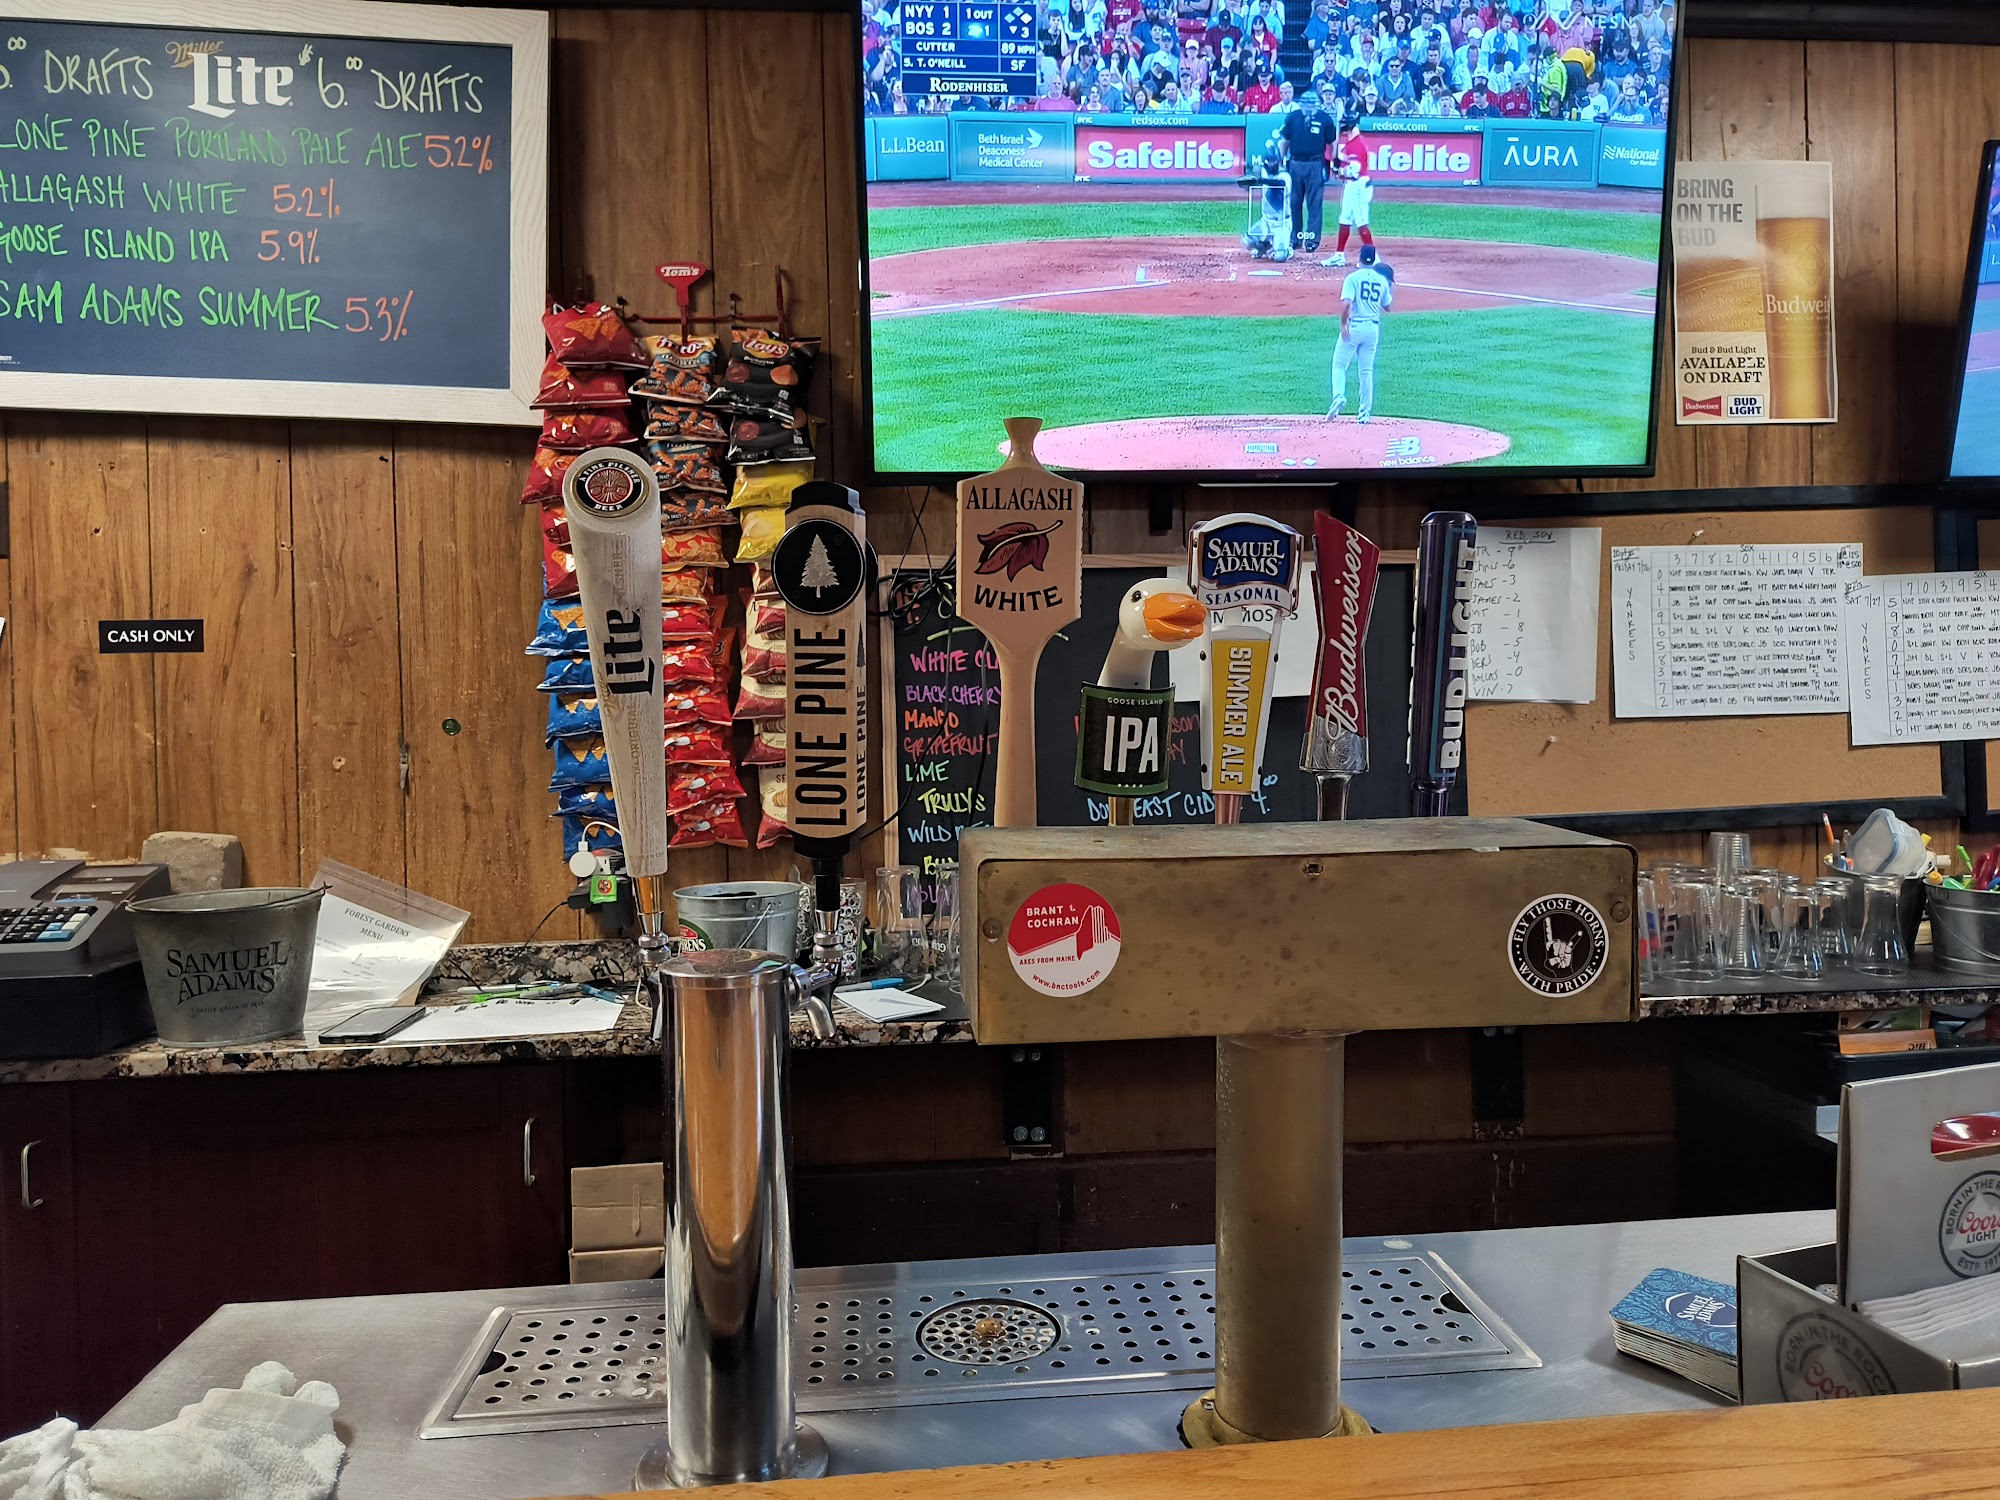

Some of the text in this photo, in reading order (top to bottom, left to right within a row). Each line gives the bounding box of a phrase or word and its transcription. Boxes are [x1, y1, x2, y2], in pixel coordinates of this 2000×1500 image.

[905, 4, 950, 19] NYY 1
[966, 7, 993, 20] 1 OUT
[905, 22, 951, 36] BOS 2
[1021, 26, 1030, 38] 3
[165, 40, 225, 68] Miller
[916, 41, 956, 52] CUTTER
[1001, 42, 1036, 55] 89 MPH
[927, 58, 967, 69] O'NEILL
[1010, 59, 1026, 72] SF
[44, 48, 153, 100] DRAFTS
[187, 52, 294, 118] Lite
[371, 64, 483, 113] DRAFTS
[1131, 115, 1189, 126] redsox.com
[1372, 121, 1428, 132] redsox.com
[82, 119, 155, 157] PINE
[164, 116, 288, 167] PORTLAND
[291, 127, 353, 165] PALE
[364, 132, 423, 169] ALE
[424, 134, 493, 174] 5.2%
[880, 136, 945, 154] L.L.Bean
[978, 133, 1024, 145] Beth Israel
[978, 145, 1025, 156] Deaconess
[1087, 140, 1235, 170] Safelite
[1615, 148, 1660, 161] National
[978, 156, 1044, 168] Medical Center
[0, 168, 341, 219] ALLAGASH WHITE 5.2%
[1677, 178, 1734, 199] BRING
[1677, 203, 1743, 223] ON THE
[0, 221, 320, 264] GOOSE ISLAND IPA 5.9%
[1678, 227, 1716, 246] BUD
[660, 265, 700, 277] Tom's
[1360, 280, 1382, 302] 65
[0, 280, 414, 342] SAM ADAMS SUMMER 5.3%
[1691, 346, 1708, 354] Bud
[1735, 346, 1756, 355] Light
[1684, 372, 1762, 383] ON DRAFT
[1685, 402, 1720, 411] Budweiser
[1729, 406, 1762, 415] LIGHT
[1734, 397, 1757, 406] BUD
[1379, 456, 1435, 468] new balance
[607, 462, 641, 484] PILSNER
[593, 503, 623, 511] BEER
[966, 485, 1074, 512] ALLAGASH
[1505, 530, 1525, 540] RED
[1207, 538, 1285, 559] SAMUEL
[1740, 544, 1755, 552] SOX
[1212, 557, 1279, 577] ADAMS
[974, 583, 1063, 613] WHITE
[1205, 587, 1281, 606] SEASONAL
[1324, 529, 1363, 742] Budweiser
[603, 609, 655, 697] Lite
[910, 646, 969, 673] WHITE
[1440, 538, 1477, 770] BUD LIGHT
[1473, 683, 1499, 697] VIN
[1107, 696, 1164, 706] GOOSE ISLAND
[1220, 646, 1252, 785] SUMMER ALE
[793, 628, 848, 826] LONE PINE
[856, 685, 867, 814] LONE PINE
[1103, 715, 1159, 774] IPA
[905, 760, 949, 782] LIME
[907, 820, 952, 843] WILD
[1026, 905, 1063, 917] BRANT
[344, 907, 411, 937] FOREST GARDENS
[1027, 916, 1079, 929] COCHRAN
[1513, 898, 1605, 948] FLY THOSE HORNS
[360, 927, 384, 941] MENU
[167, 941, 288, 977] SAMUEL
[1019, 958, 1035, 966] AXES
[177, 967, 275, 1006] ADAMS
[1032, 969, 1101, 991] www.bnctools.com
[1518, 961, 1597, 993] WITH PRIDE
[1945, 1178, 1995, 1235] BORN IN THE
[1966, 1229, 1997, 1244] LIGHT
[1677, 1295, 1713, 1321] SAMUEL
[1696, 1300, 1726, 1325] ADAMS
[1784, 1334, 1805, 1374] BORN
